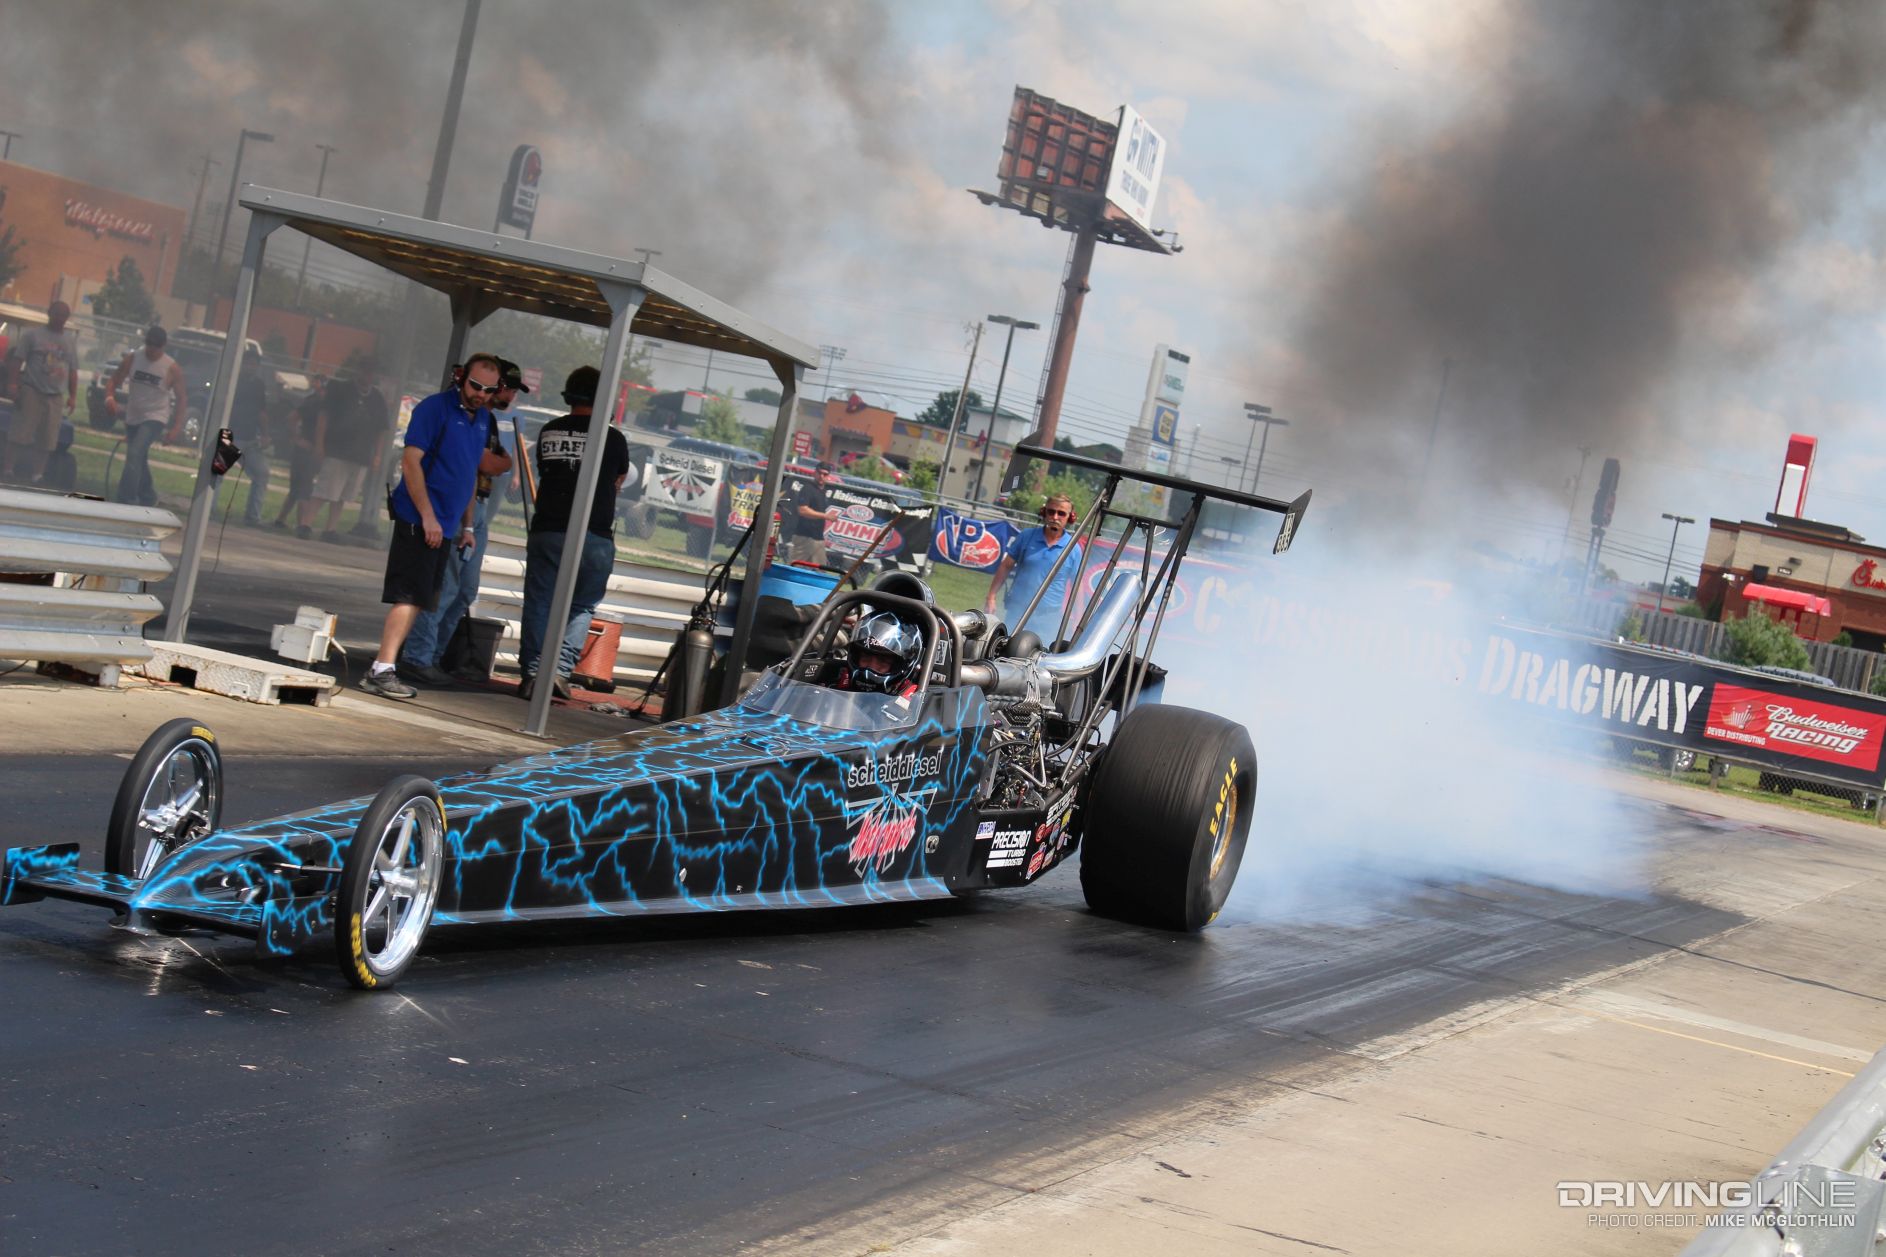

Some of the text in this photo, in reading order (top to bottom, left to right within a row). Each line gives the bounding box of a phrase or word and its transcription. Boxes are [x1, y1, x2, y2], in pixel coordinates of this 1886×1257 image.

[542, 439, 587, 454] STAF
[659, 453, 717, 475] Scheid Diesel
[734, 499, 754, 511] TRA
[736, 491, 762, 504] KING
[832, 489, 872, 507] National
[943, 515, 986, 560] VP
[1479, 634, 1704, 734] DRAGWAY
[1766, 704, 1868, 737] Budweiser
[1726, 730, 1766, 746] DISTRIBUTING
[847, 744, 945, 788] scheiddiesel
[1209, 756, 1238, 837] EAGLE
[991, 830, 1032, 849] PRECISION
[1007, 849, 1026, 858] TURBO
